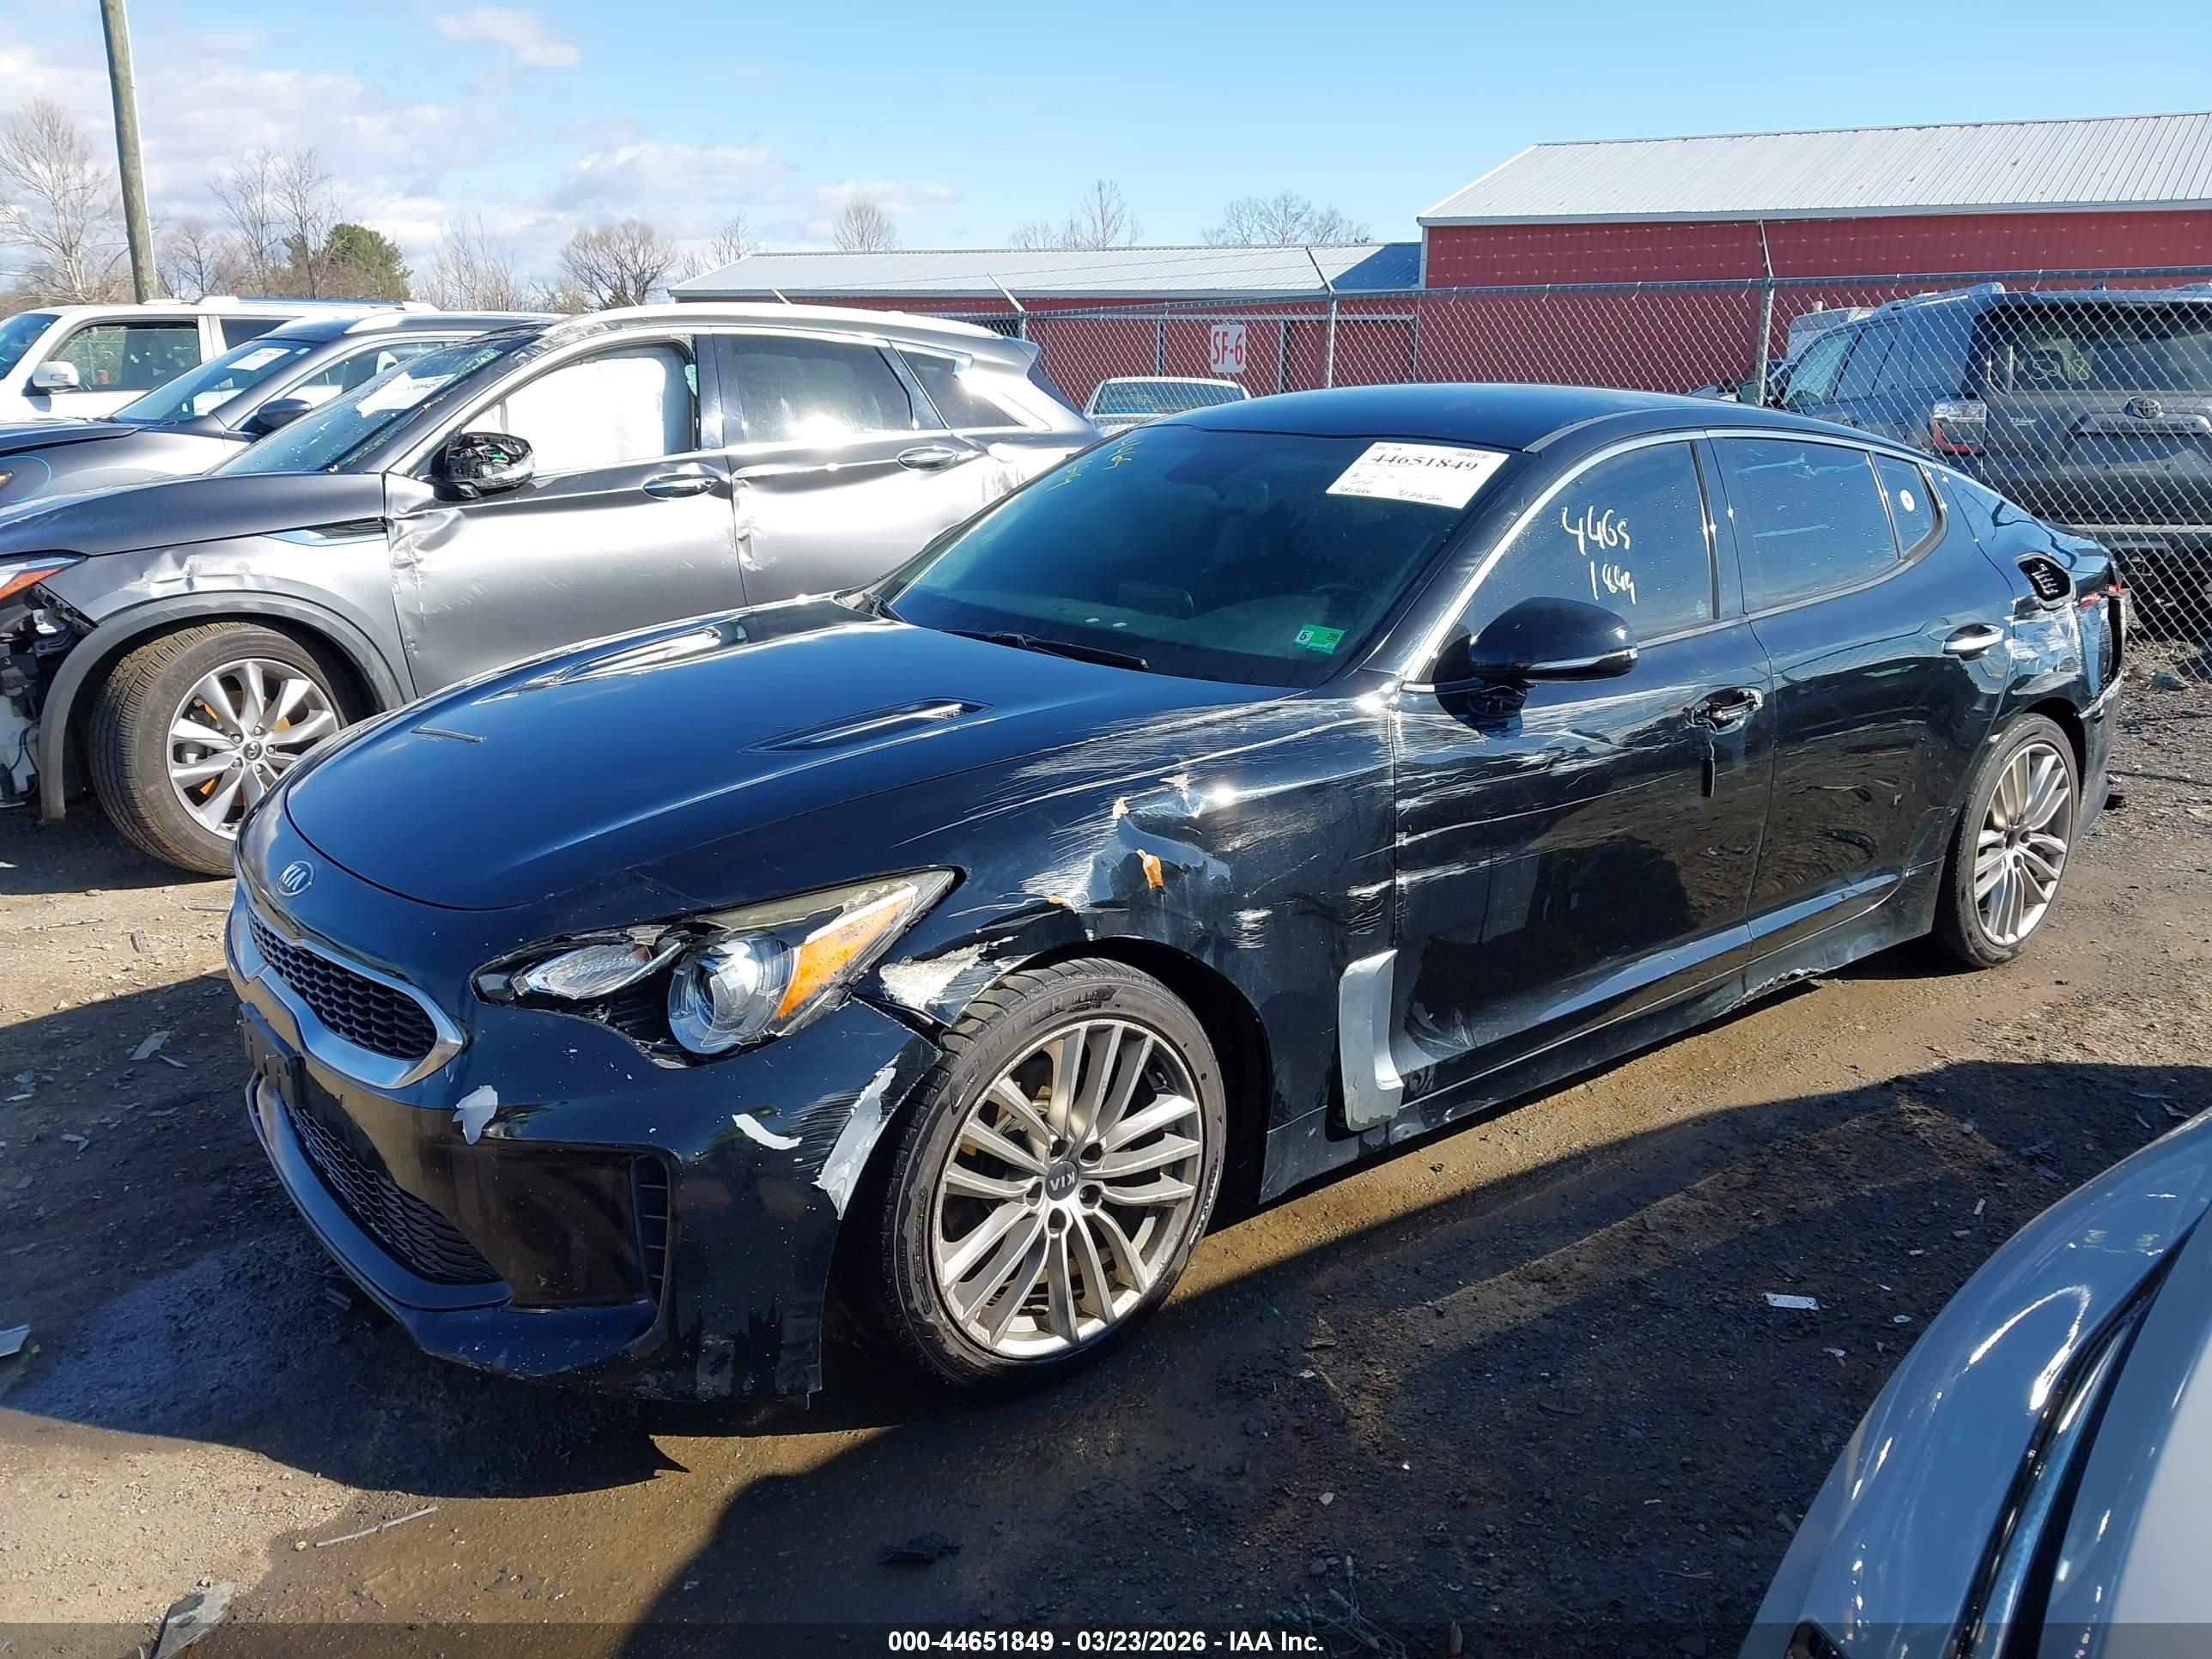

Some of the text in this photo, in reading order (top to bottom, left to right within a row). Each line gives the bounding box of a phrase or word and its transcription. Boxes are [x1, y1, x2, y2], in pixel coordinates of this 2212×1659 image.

[1212, 331, 1243, 366] SF-6
[1371, 453, 1479, 471] 44651849
[1562, 505, 1631, 556] 4465
[1049, 1170, 1075, 1191] KIA
